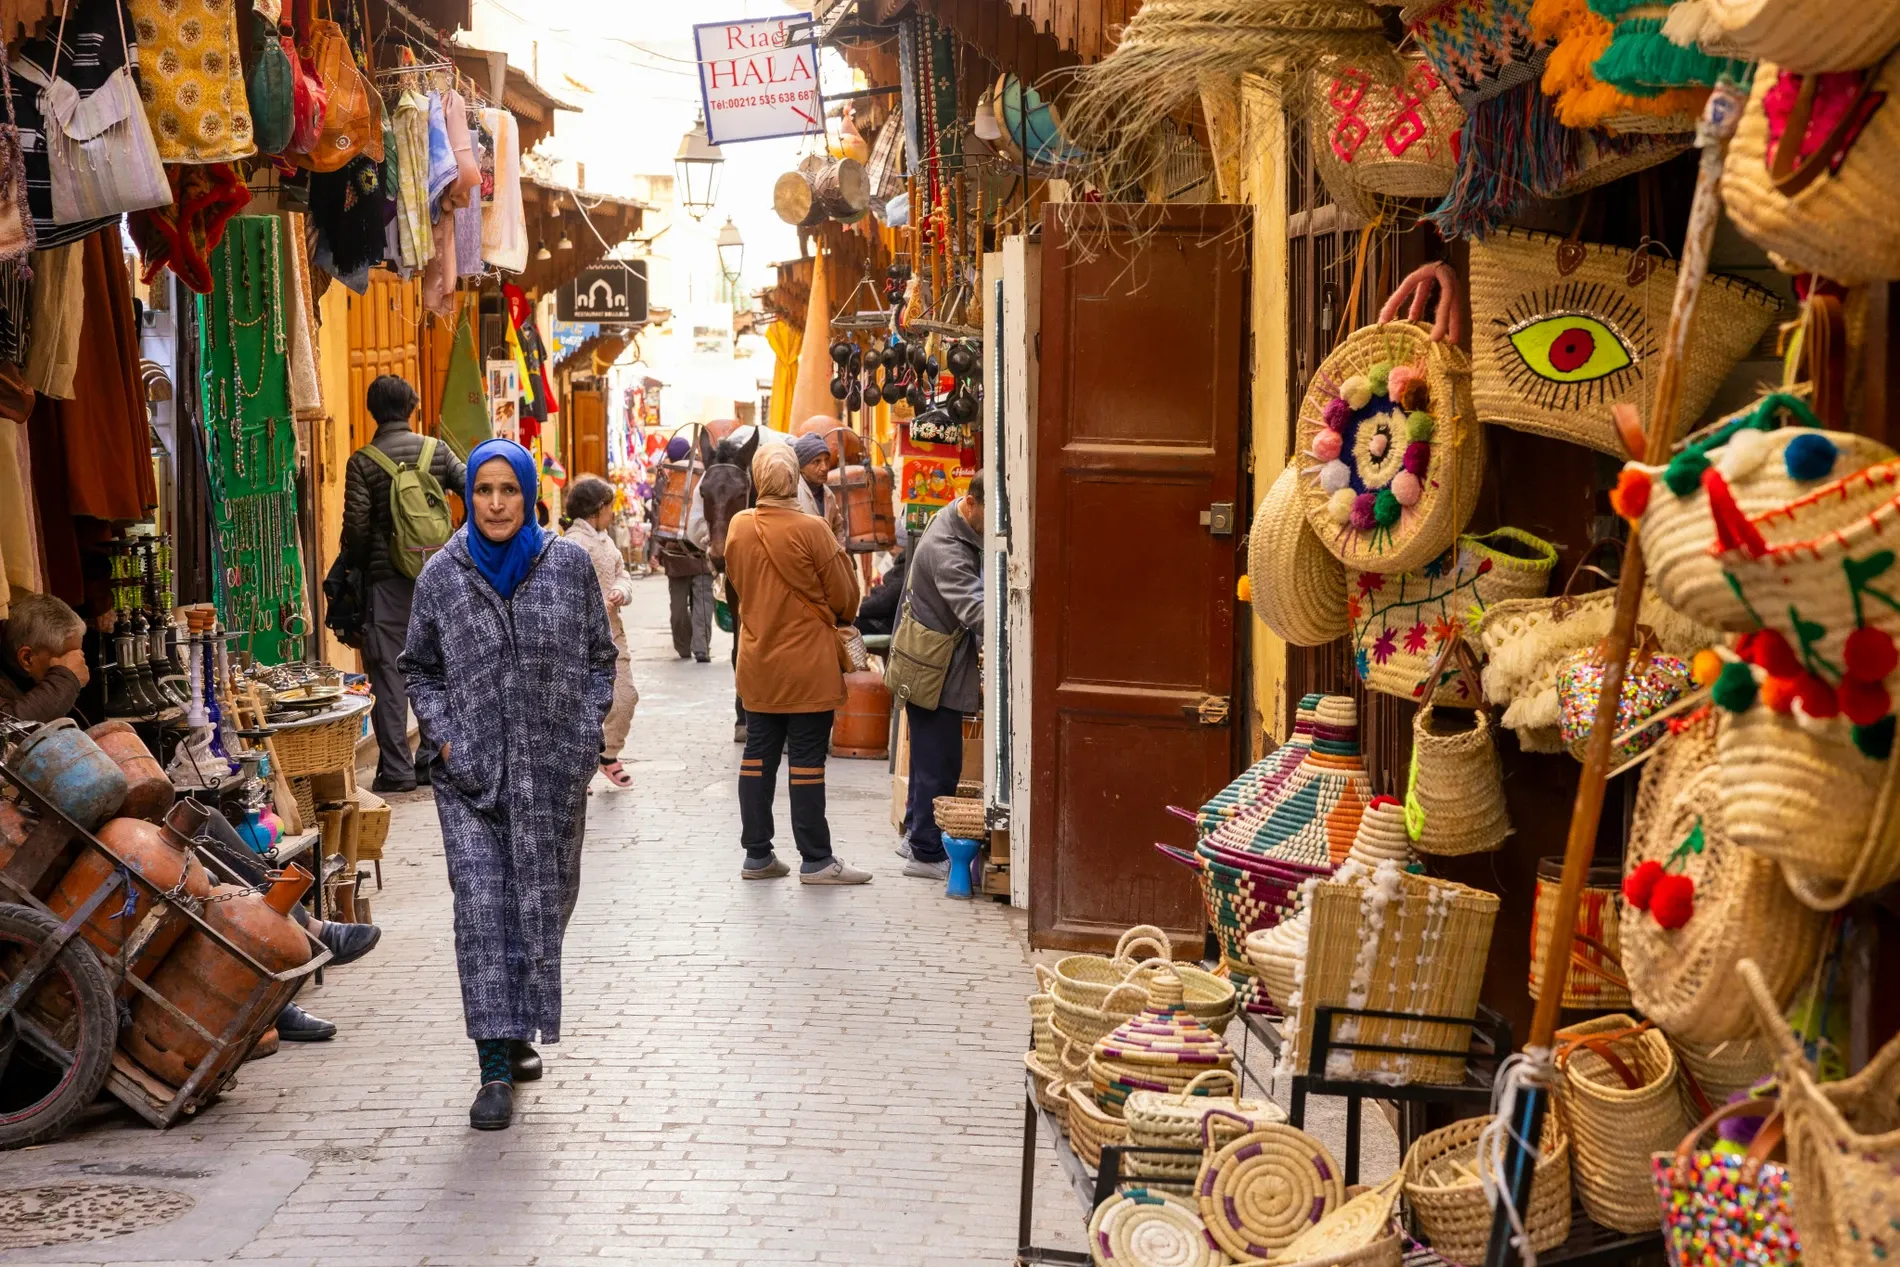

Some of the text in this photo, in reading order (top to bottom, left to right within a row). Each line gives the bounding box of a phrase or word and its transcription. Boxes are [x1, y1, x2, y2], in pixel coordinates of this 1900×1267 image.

[726, 20, 785, 50] Riad
[708, 53, 812, 89] HALA
[759, 94, 776, 105] 535
[778, 92, 796, 103] 638
[798, 90, 815, 101] 687
